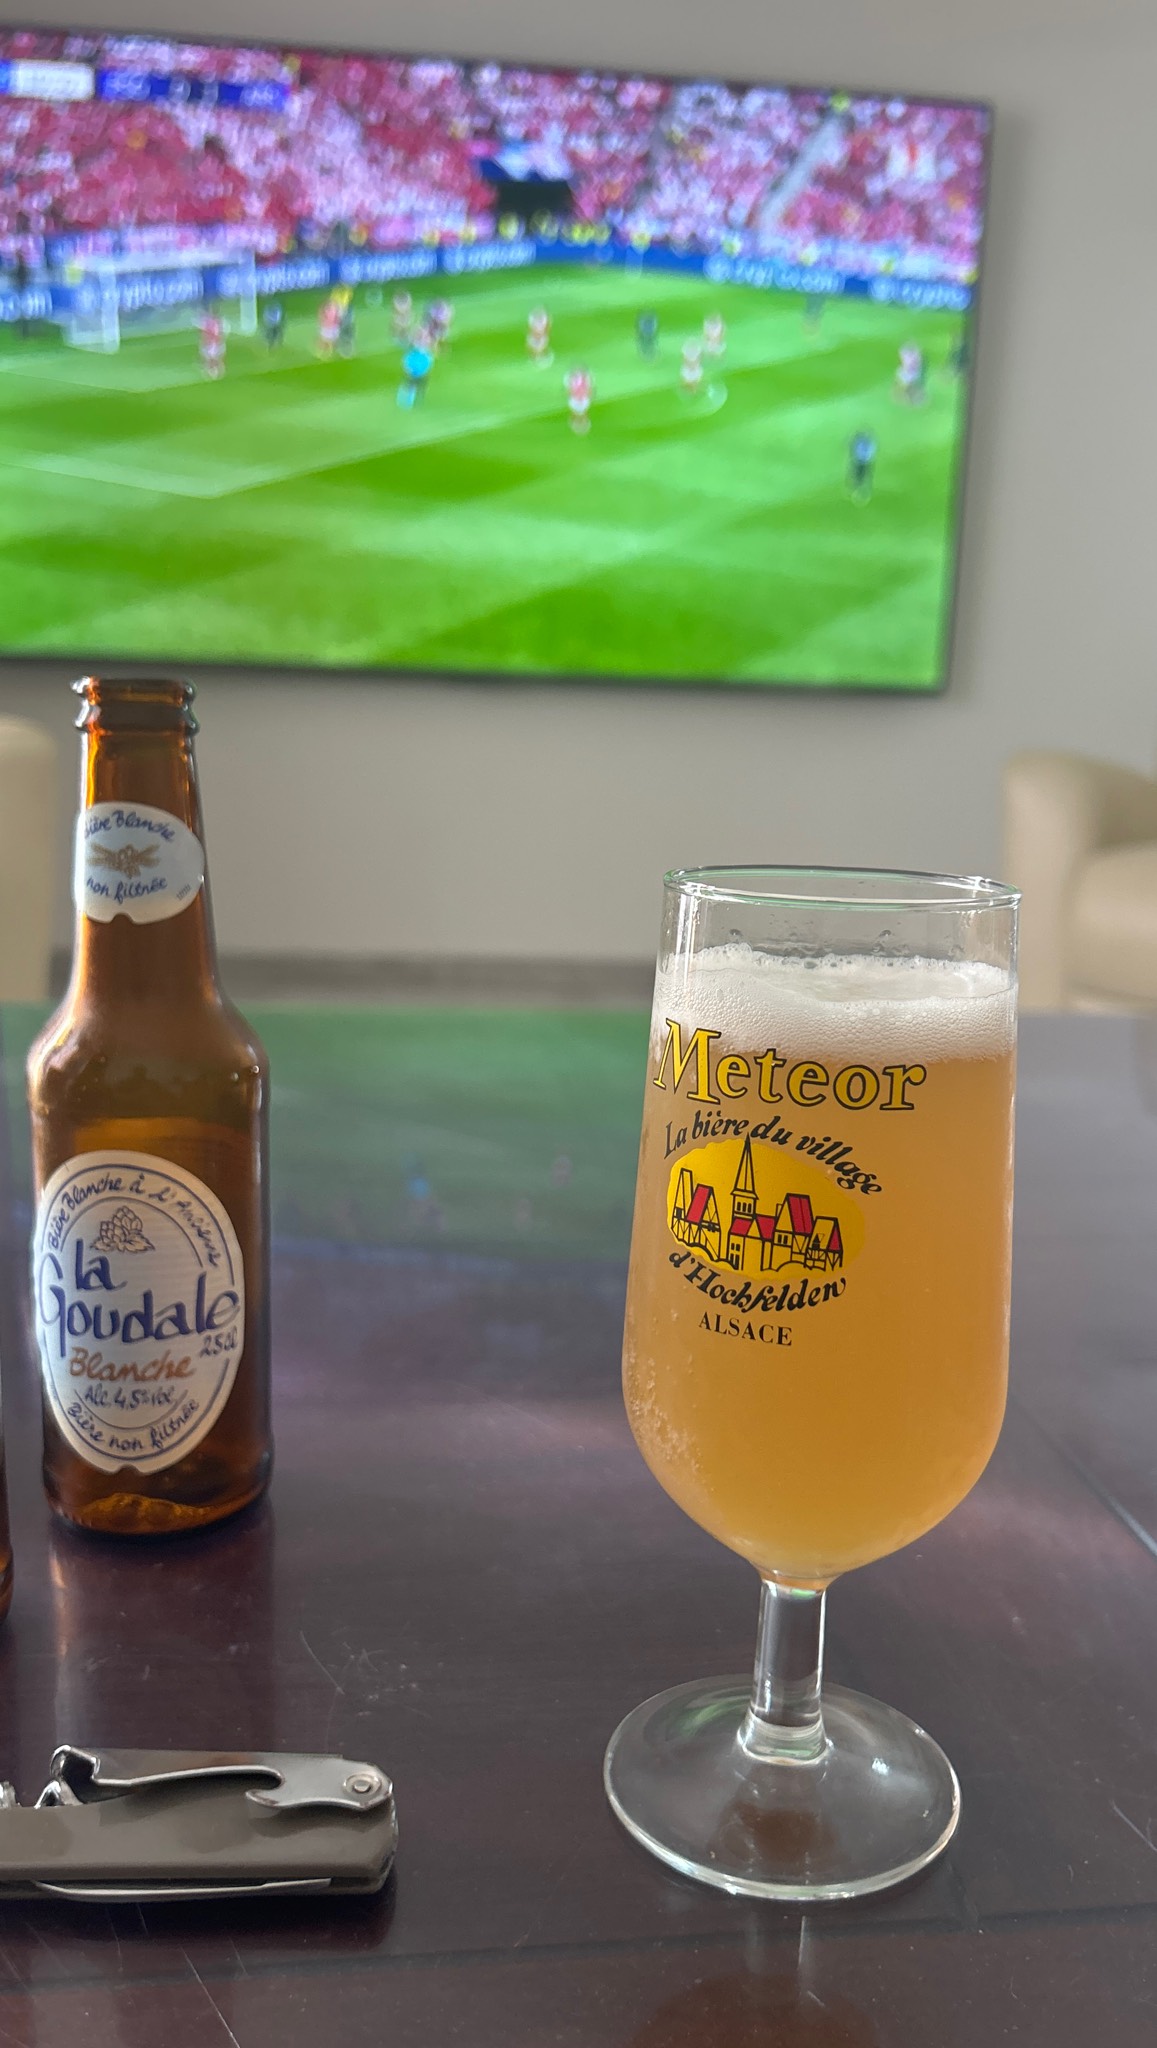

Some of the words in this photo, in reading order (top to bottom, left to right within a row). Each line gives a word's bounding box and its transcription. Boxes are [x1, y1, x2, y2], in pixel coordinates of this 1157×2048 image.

[112, 810, 175, 842] Blanche
[87, 877, 110, 897] non
[114, 877, 168, 905] filtrée
[653, 1018, 927, 1111] Meteor
[664, 1120, 688, 1160] La
[692, 1110, 750, 1140] bière
[750, 1115, 793, 1146] du
[795, 1136, 883, 1196] village
[48, 1207, 70, 1250] Bière
[62, 1172, 125, 1211] Blanche
[129, 1172, 146, 1195] à
[39, 1253, 240, 1359] Goudale
[668, 1250, 848, 1314] d'Hochfelden
[698, 1311, 793, 1347] ALSACE
[70, 1347, 197, 1382] Blanche
[67, 1402, 104, 1442] Bière
[109, 1434, 144, 1450] non
[150, 1400, 200, 1449] filtrée
